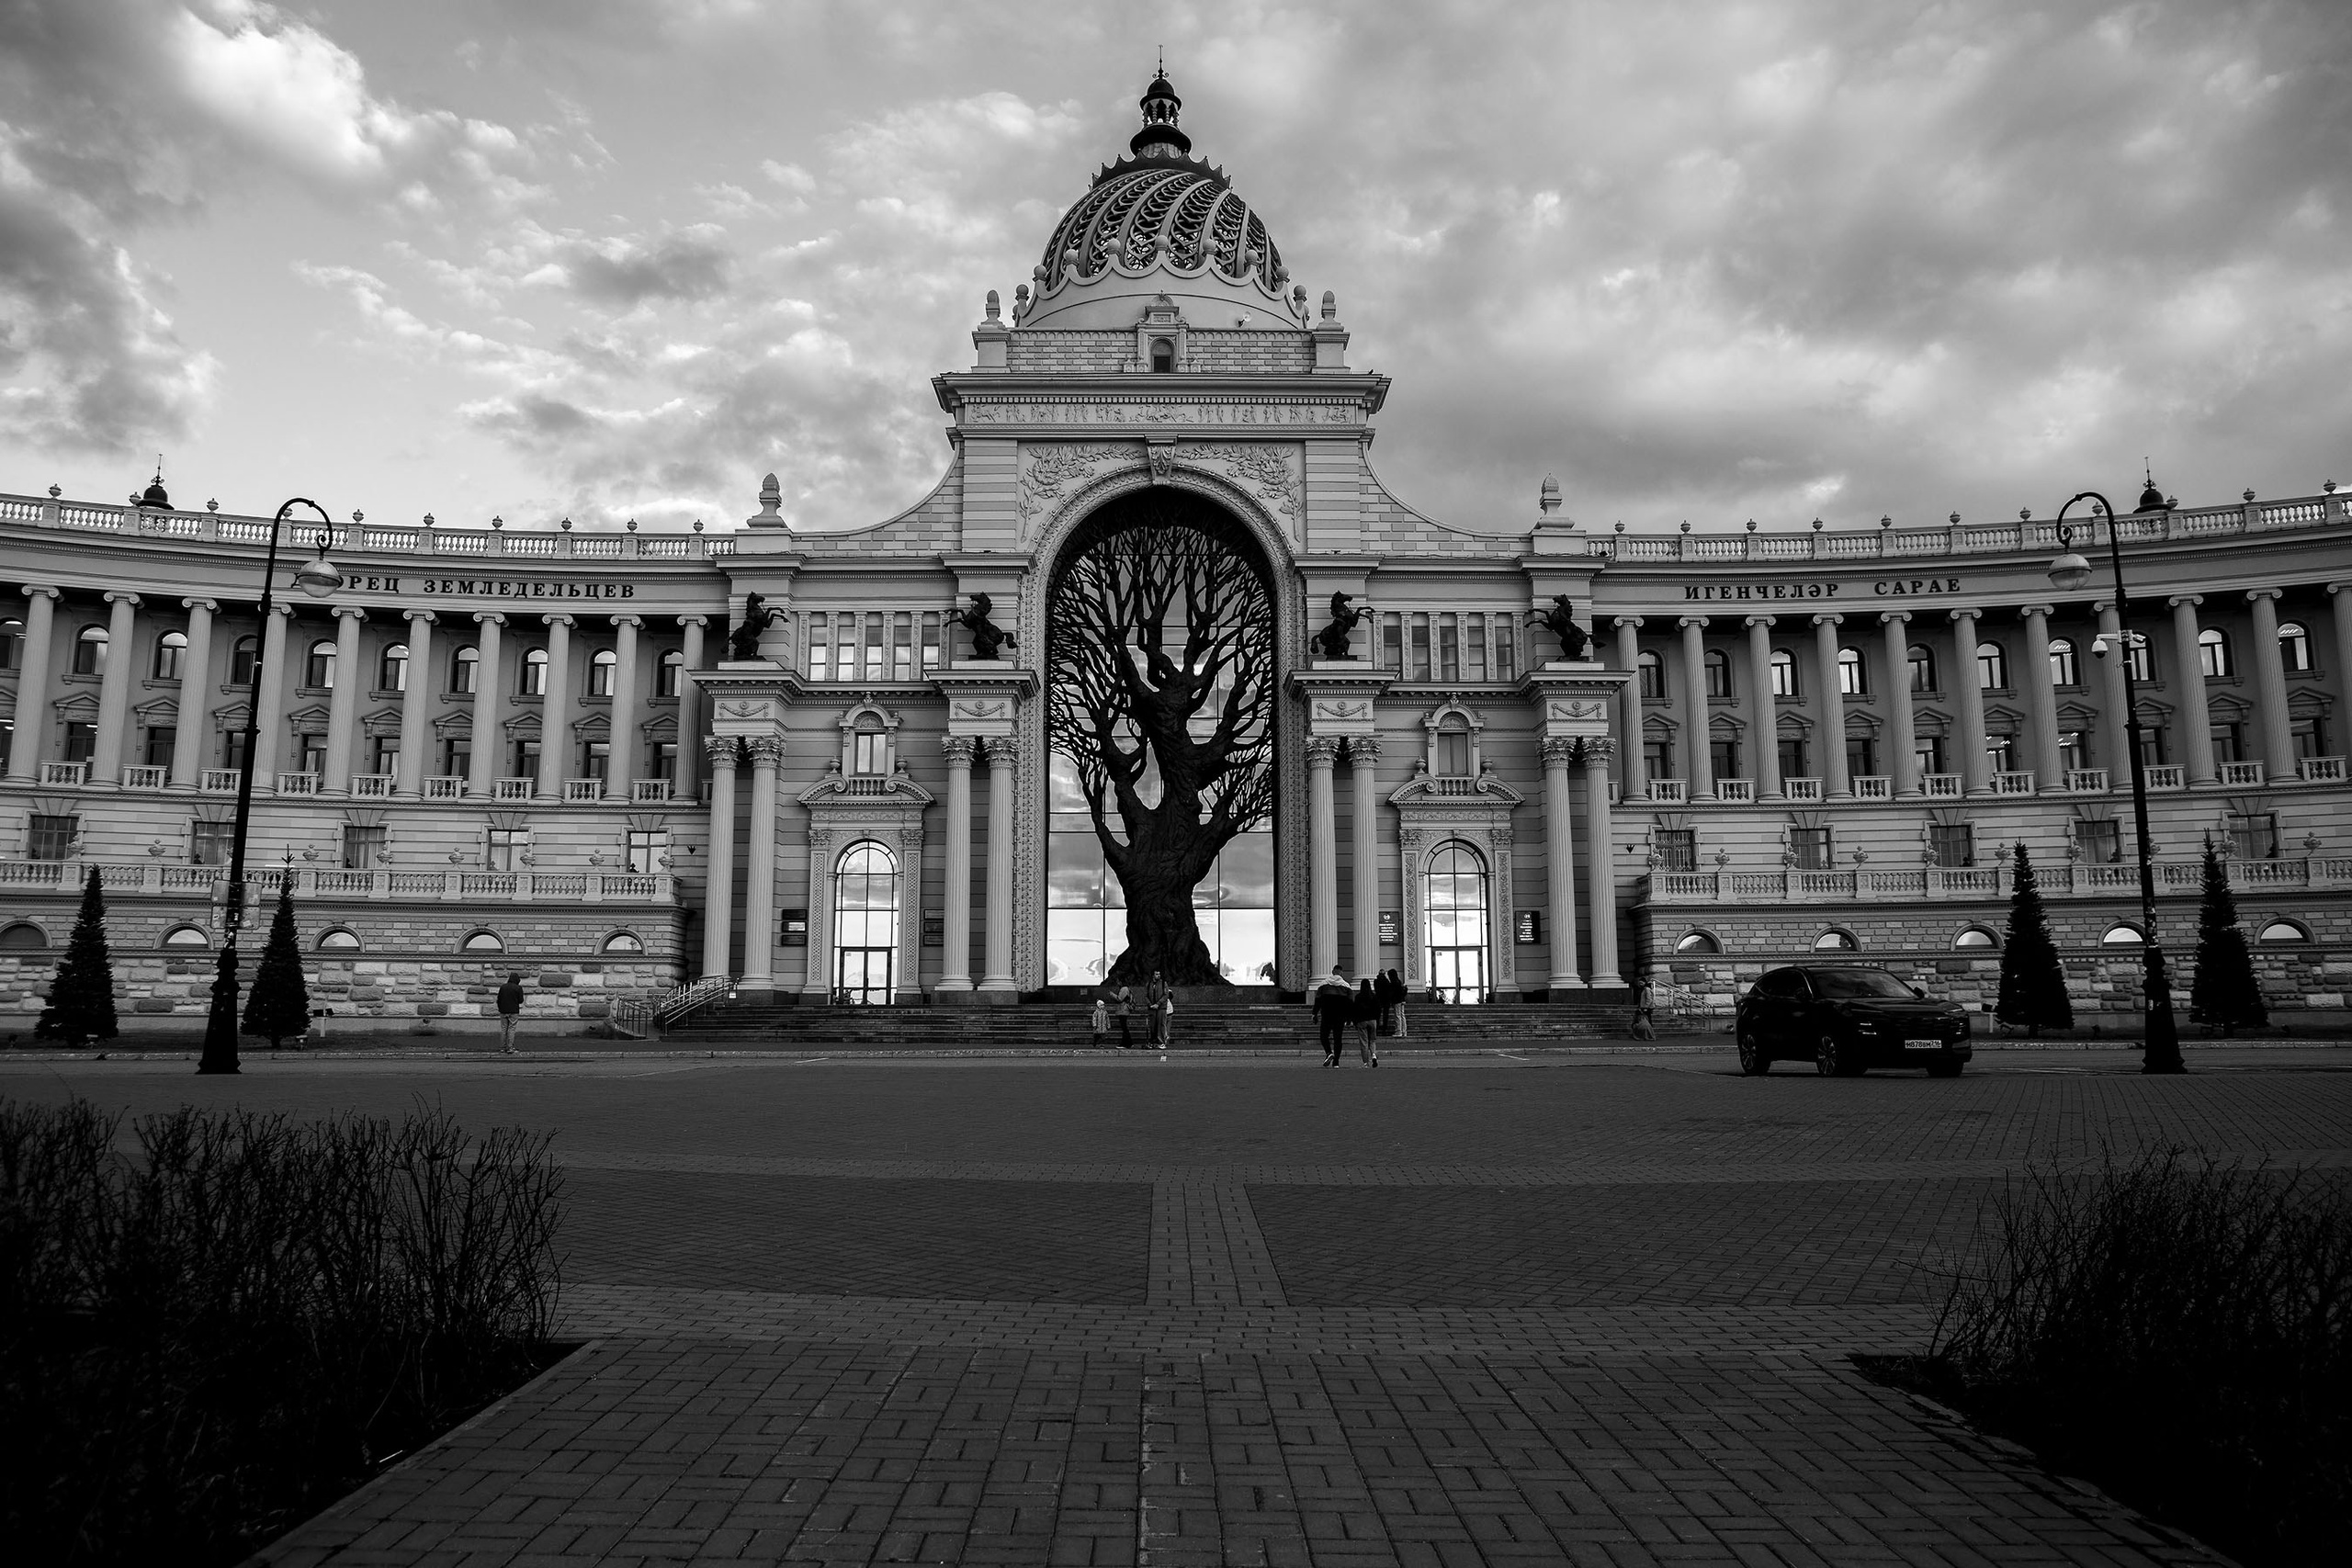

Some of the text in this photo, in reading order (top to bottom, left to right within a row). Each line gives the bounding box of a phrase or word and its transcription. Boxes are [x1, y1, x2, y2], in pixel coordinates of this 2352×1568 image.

[424, 579, 635, 600] ЗЕМЛЕДЕЛЬЦЕВ
[1684, 579, 1961, 600] ИГЕНЧЕЛӘР САРАЕ
